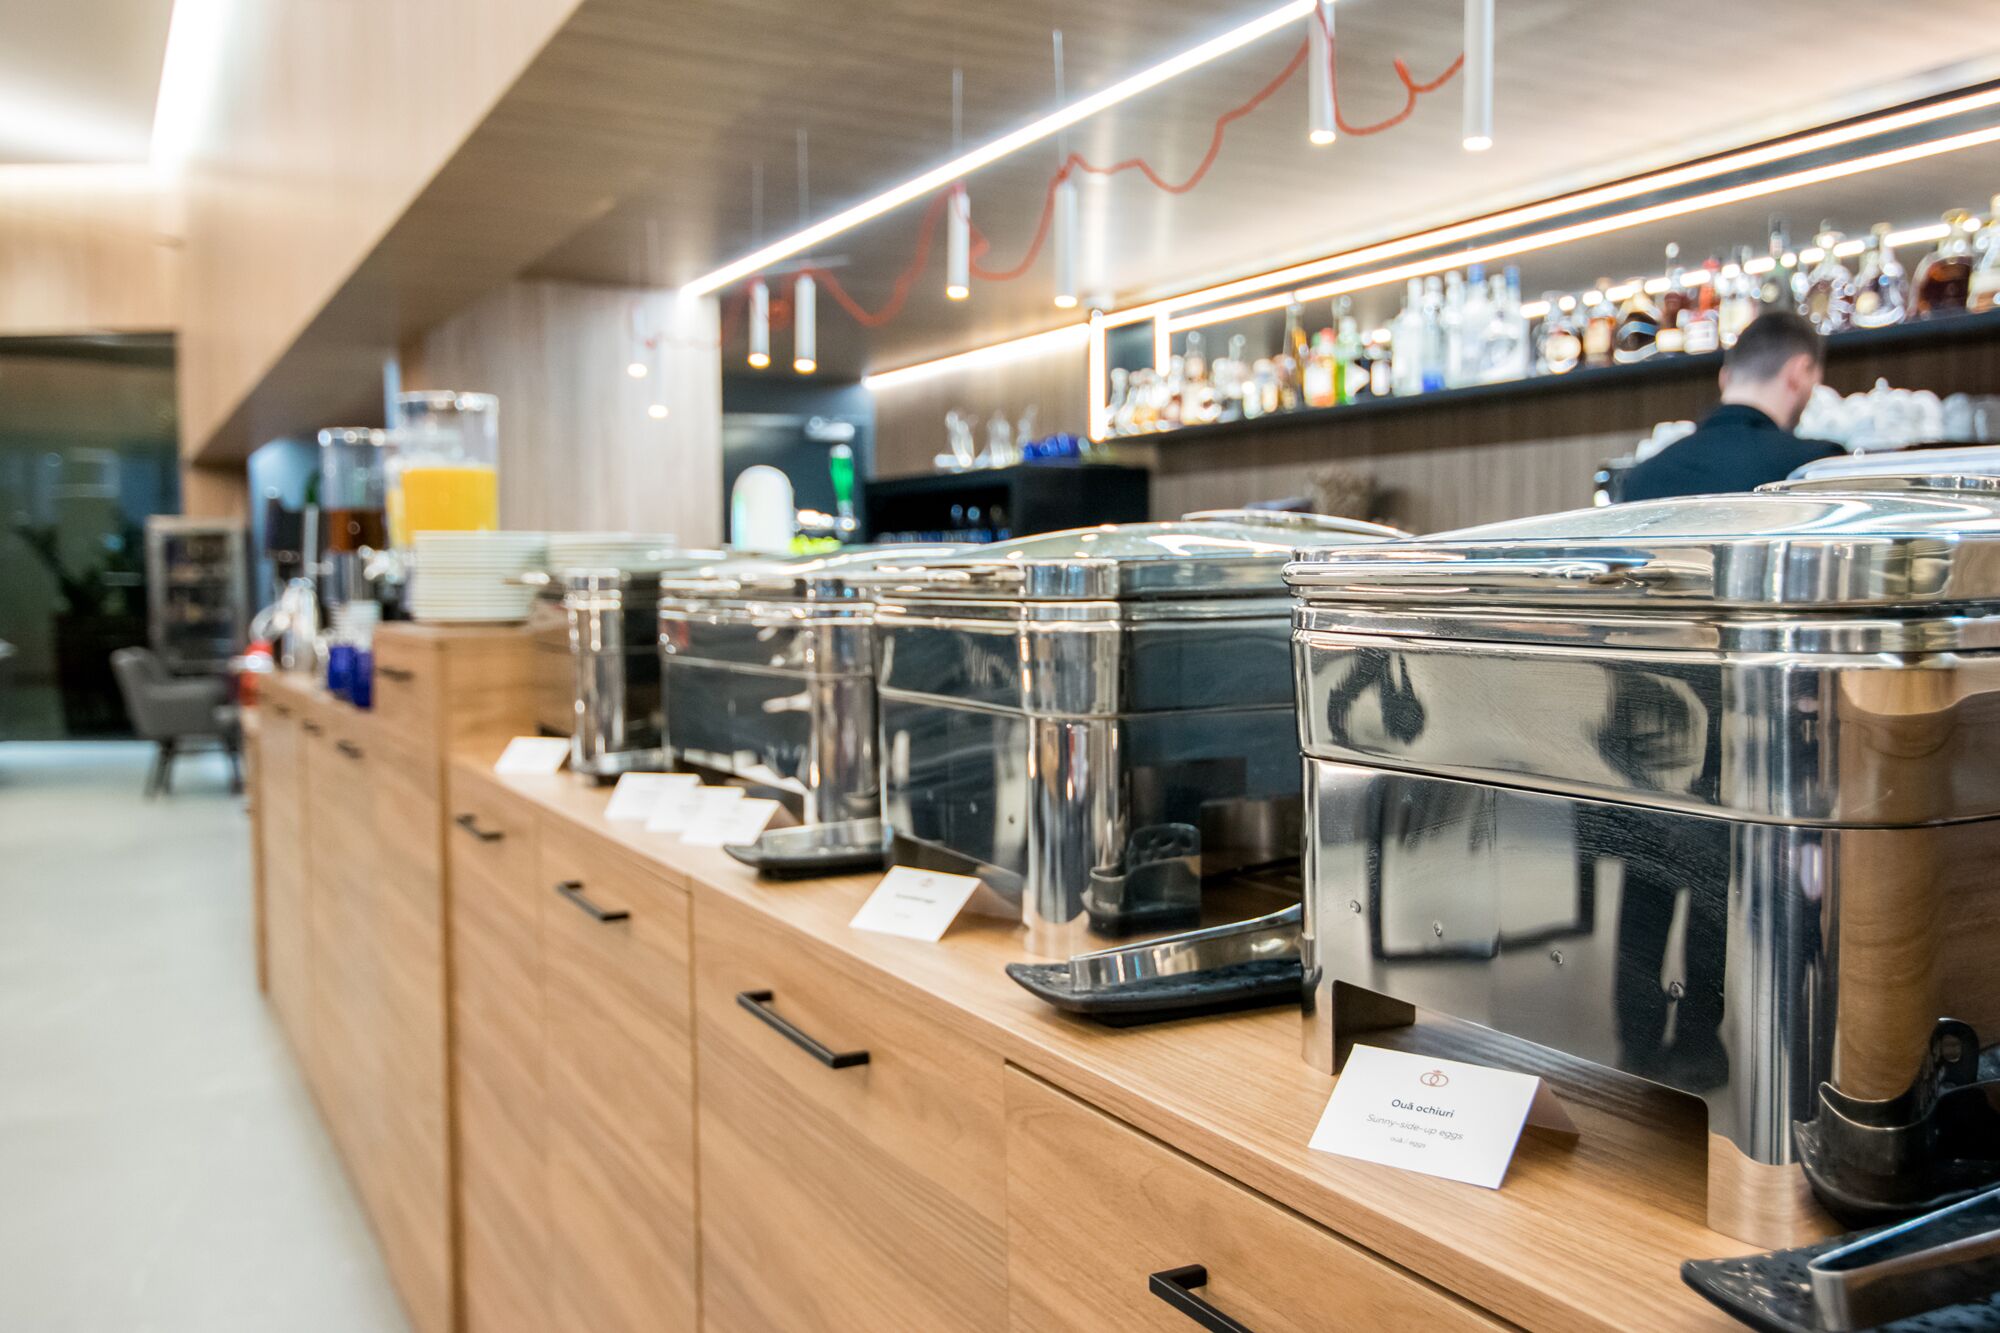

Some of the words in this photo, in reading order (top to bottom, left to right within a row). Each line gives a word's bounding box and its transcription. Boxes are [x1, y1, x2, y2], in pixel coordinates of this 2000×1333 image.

[1391, 1099, 1414, 1111] Ouă
[1416, 1105, 1455, 1118] ochiuri
[1367, 1113, 1438, 1135] Sunny-side-up
[1438, 1130, 1464, 1141] eggs
